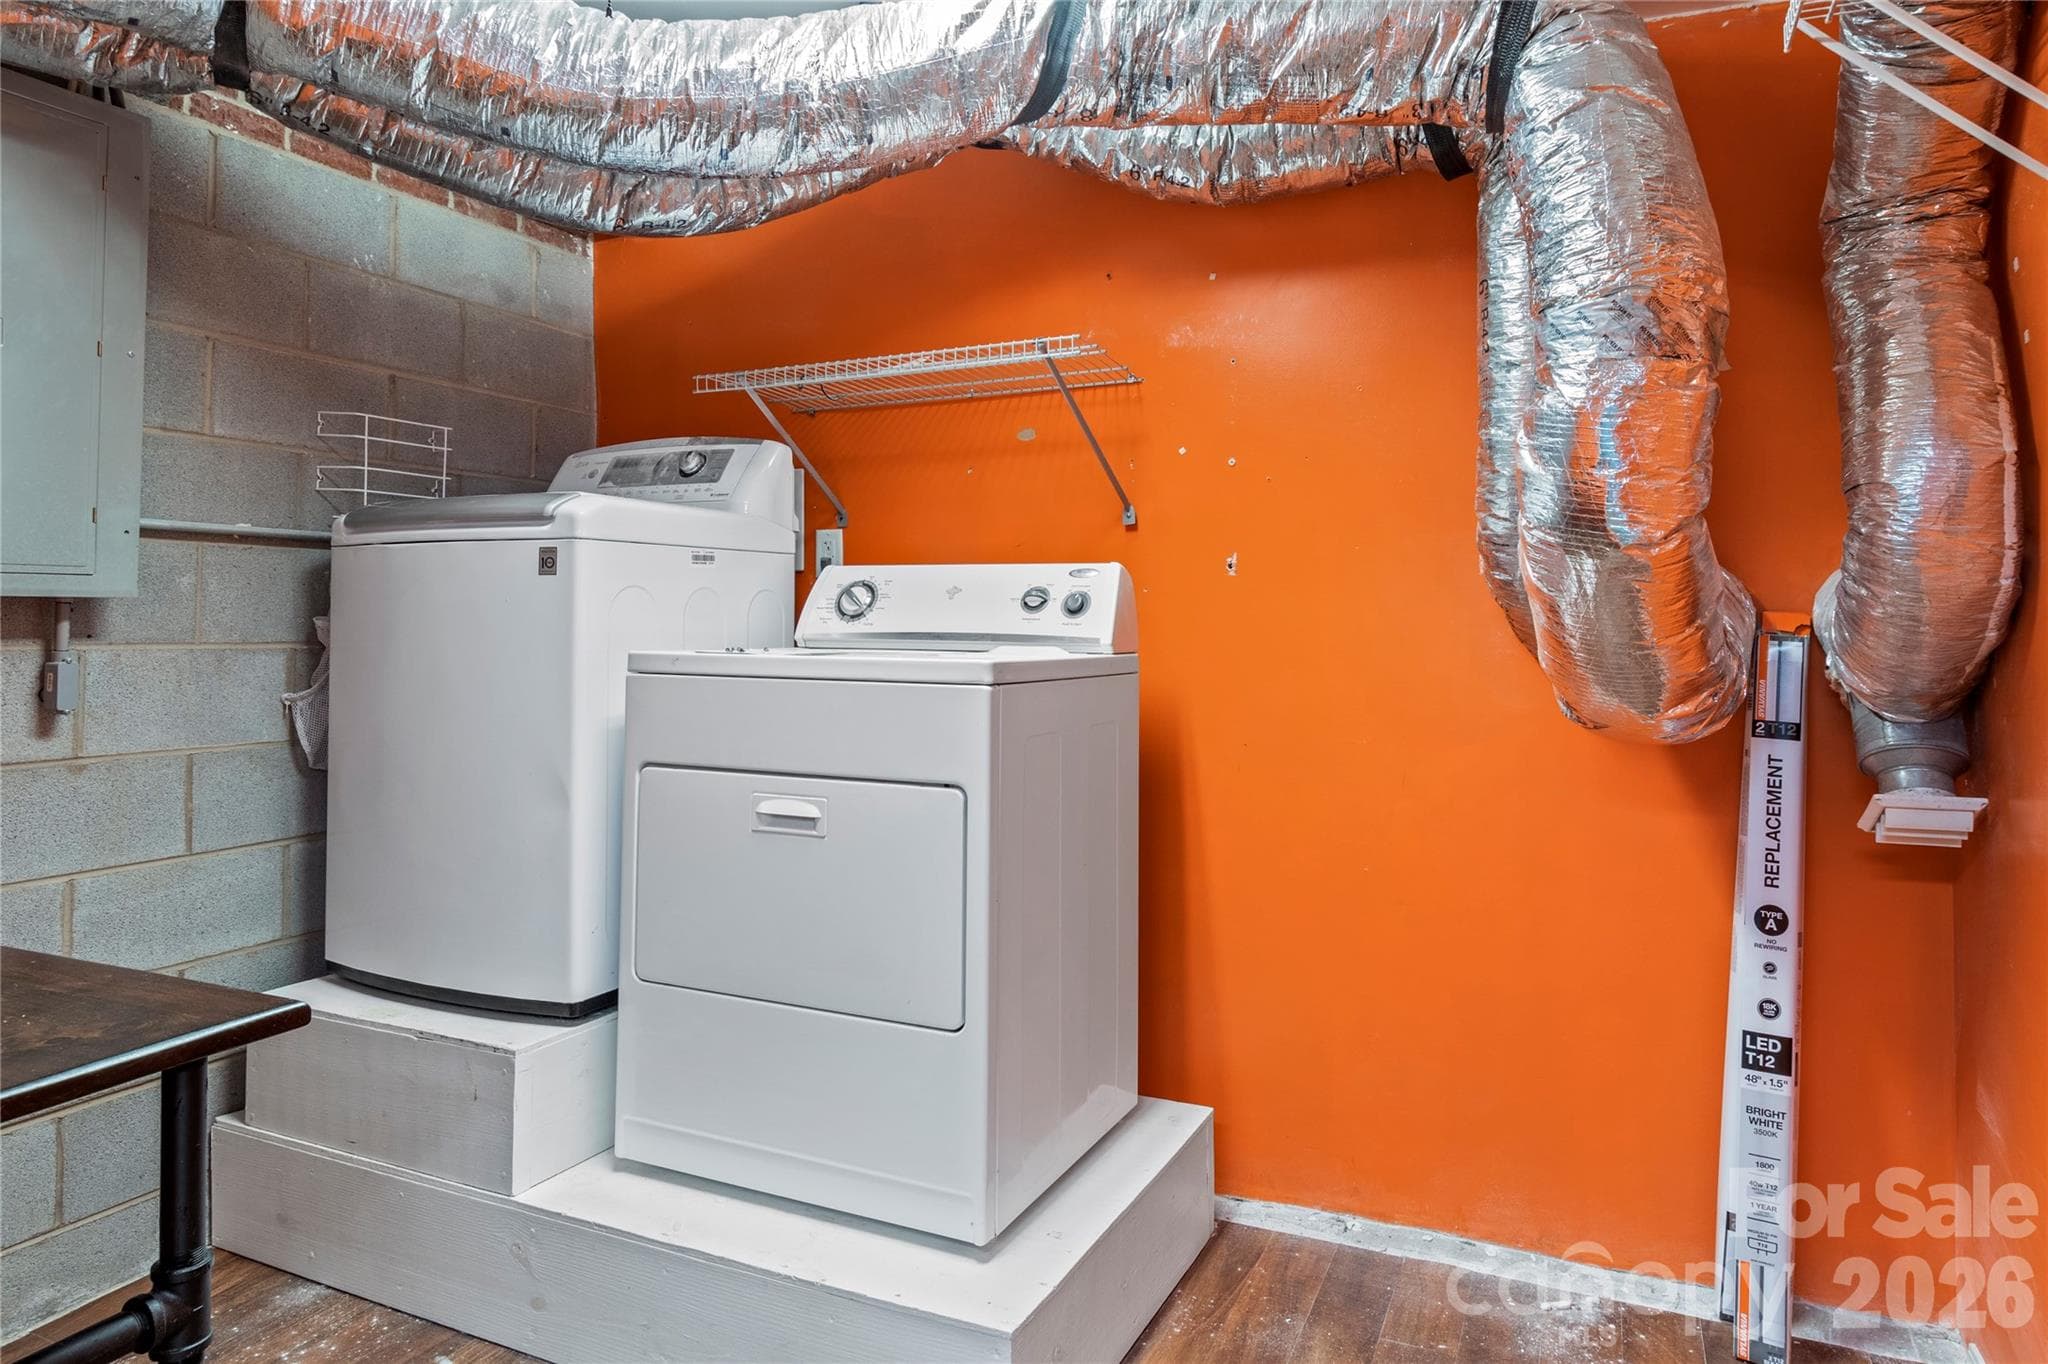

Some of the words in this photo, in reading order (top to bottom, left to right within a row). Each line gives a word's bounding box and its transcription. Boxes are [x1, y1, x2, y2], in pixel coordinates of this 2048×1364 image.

[1758, 679, 1766, 718] SYLVANIA
[1755, 721, 1765, 733] 2
[1768, 722, 1797, 736] T12
[1764, 754, 1784, 889] REPLACEMENT
[1760, 910, 1783, 920] TYPE
[1764, 918, 1778, 931] A
[1754, 942, 1787, 952] REWIRING
[1745, 1034, 1782, 1053] LED
[1745, 1051, 1776, 1069] T12
[1769, 1078, 1789, 1089] 1.5"
[1745, 1105, 1787, 1121] BRIGHT
[1748, 1116, 1784, 1131] WHITE
[1753, 1127, 1778, 1138] 3500K
[1755, 1161, 1775, 1171] 1800
[1765, 1183, 1779, 1192] T12
[1756, 1203, 1778, 1213] YEAR
